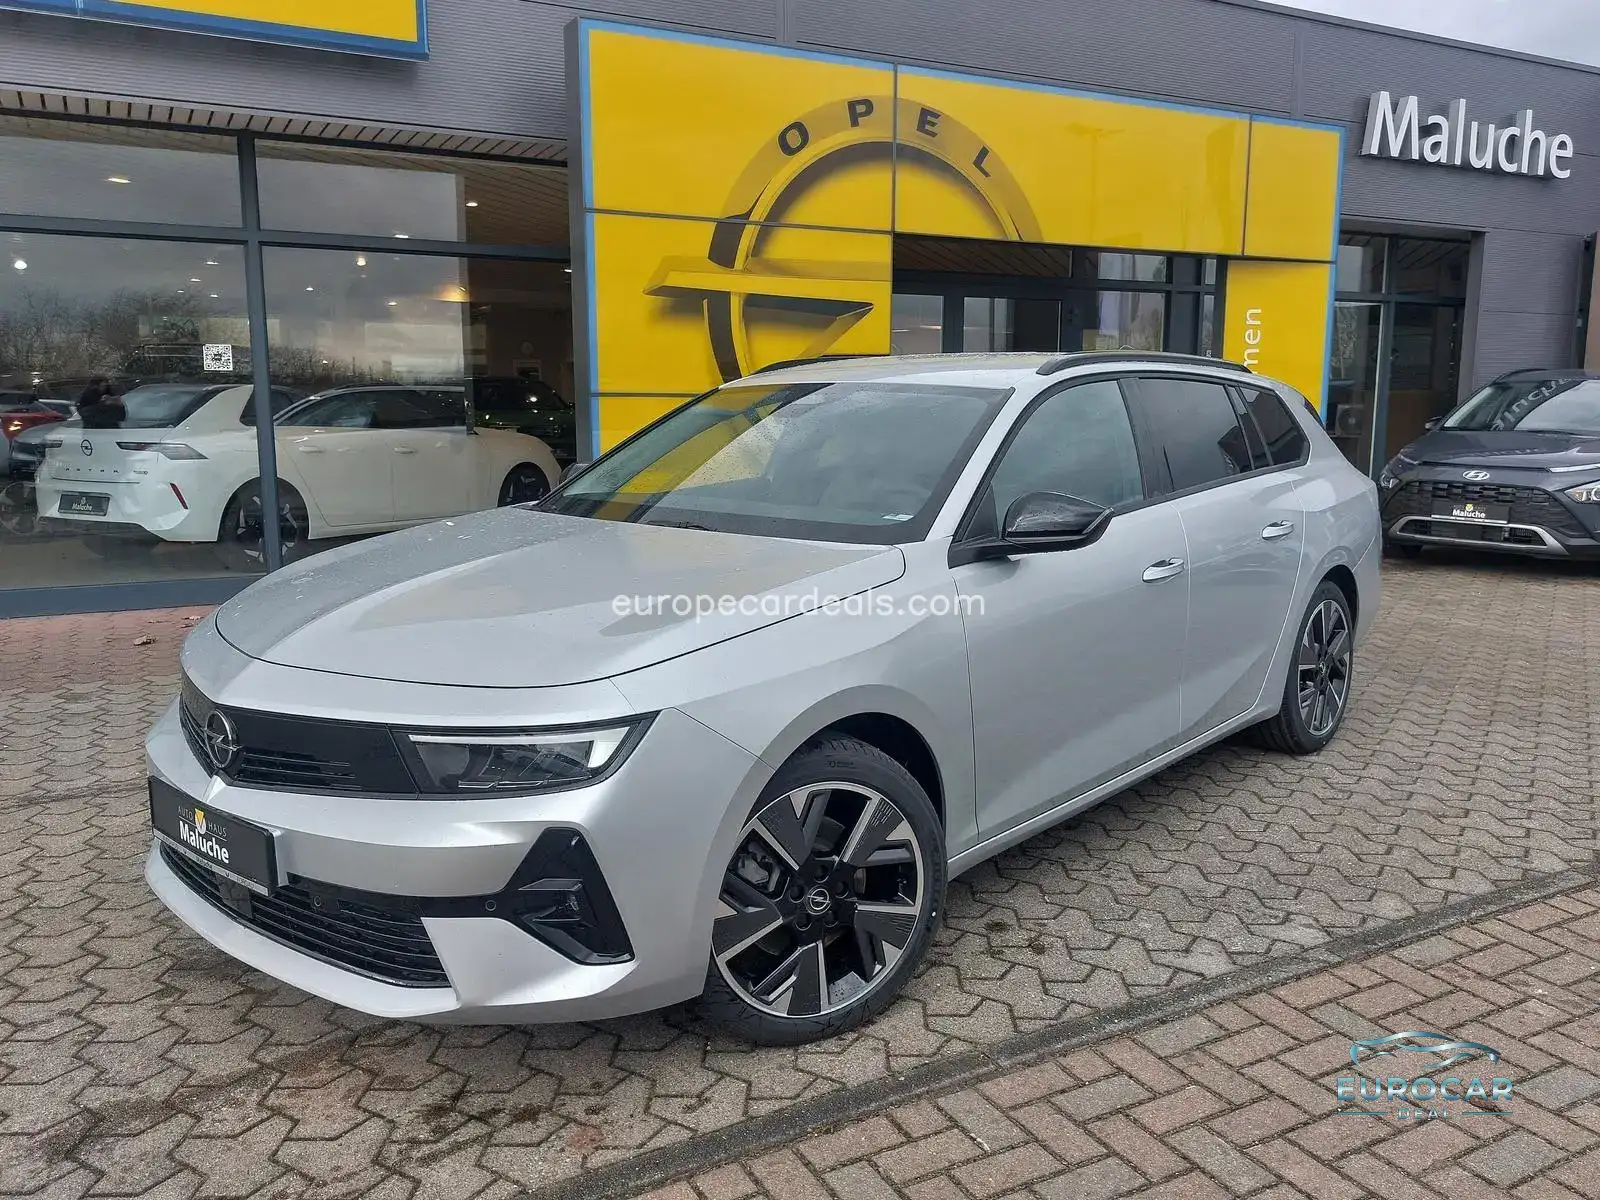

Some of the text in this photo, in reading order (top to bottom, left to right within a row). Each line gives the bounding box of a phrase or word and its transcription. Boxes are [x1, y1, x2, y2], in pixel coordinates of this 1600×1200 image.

[777, 98, 991, 178] OPEL
[1363, 91, 1573, 179] Maluche
[1452, 508, 1486, 519] Maluche
[177, 805, 228, 838] AUTO HAUS
[179, 820, 230, 864] Maluche
